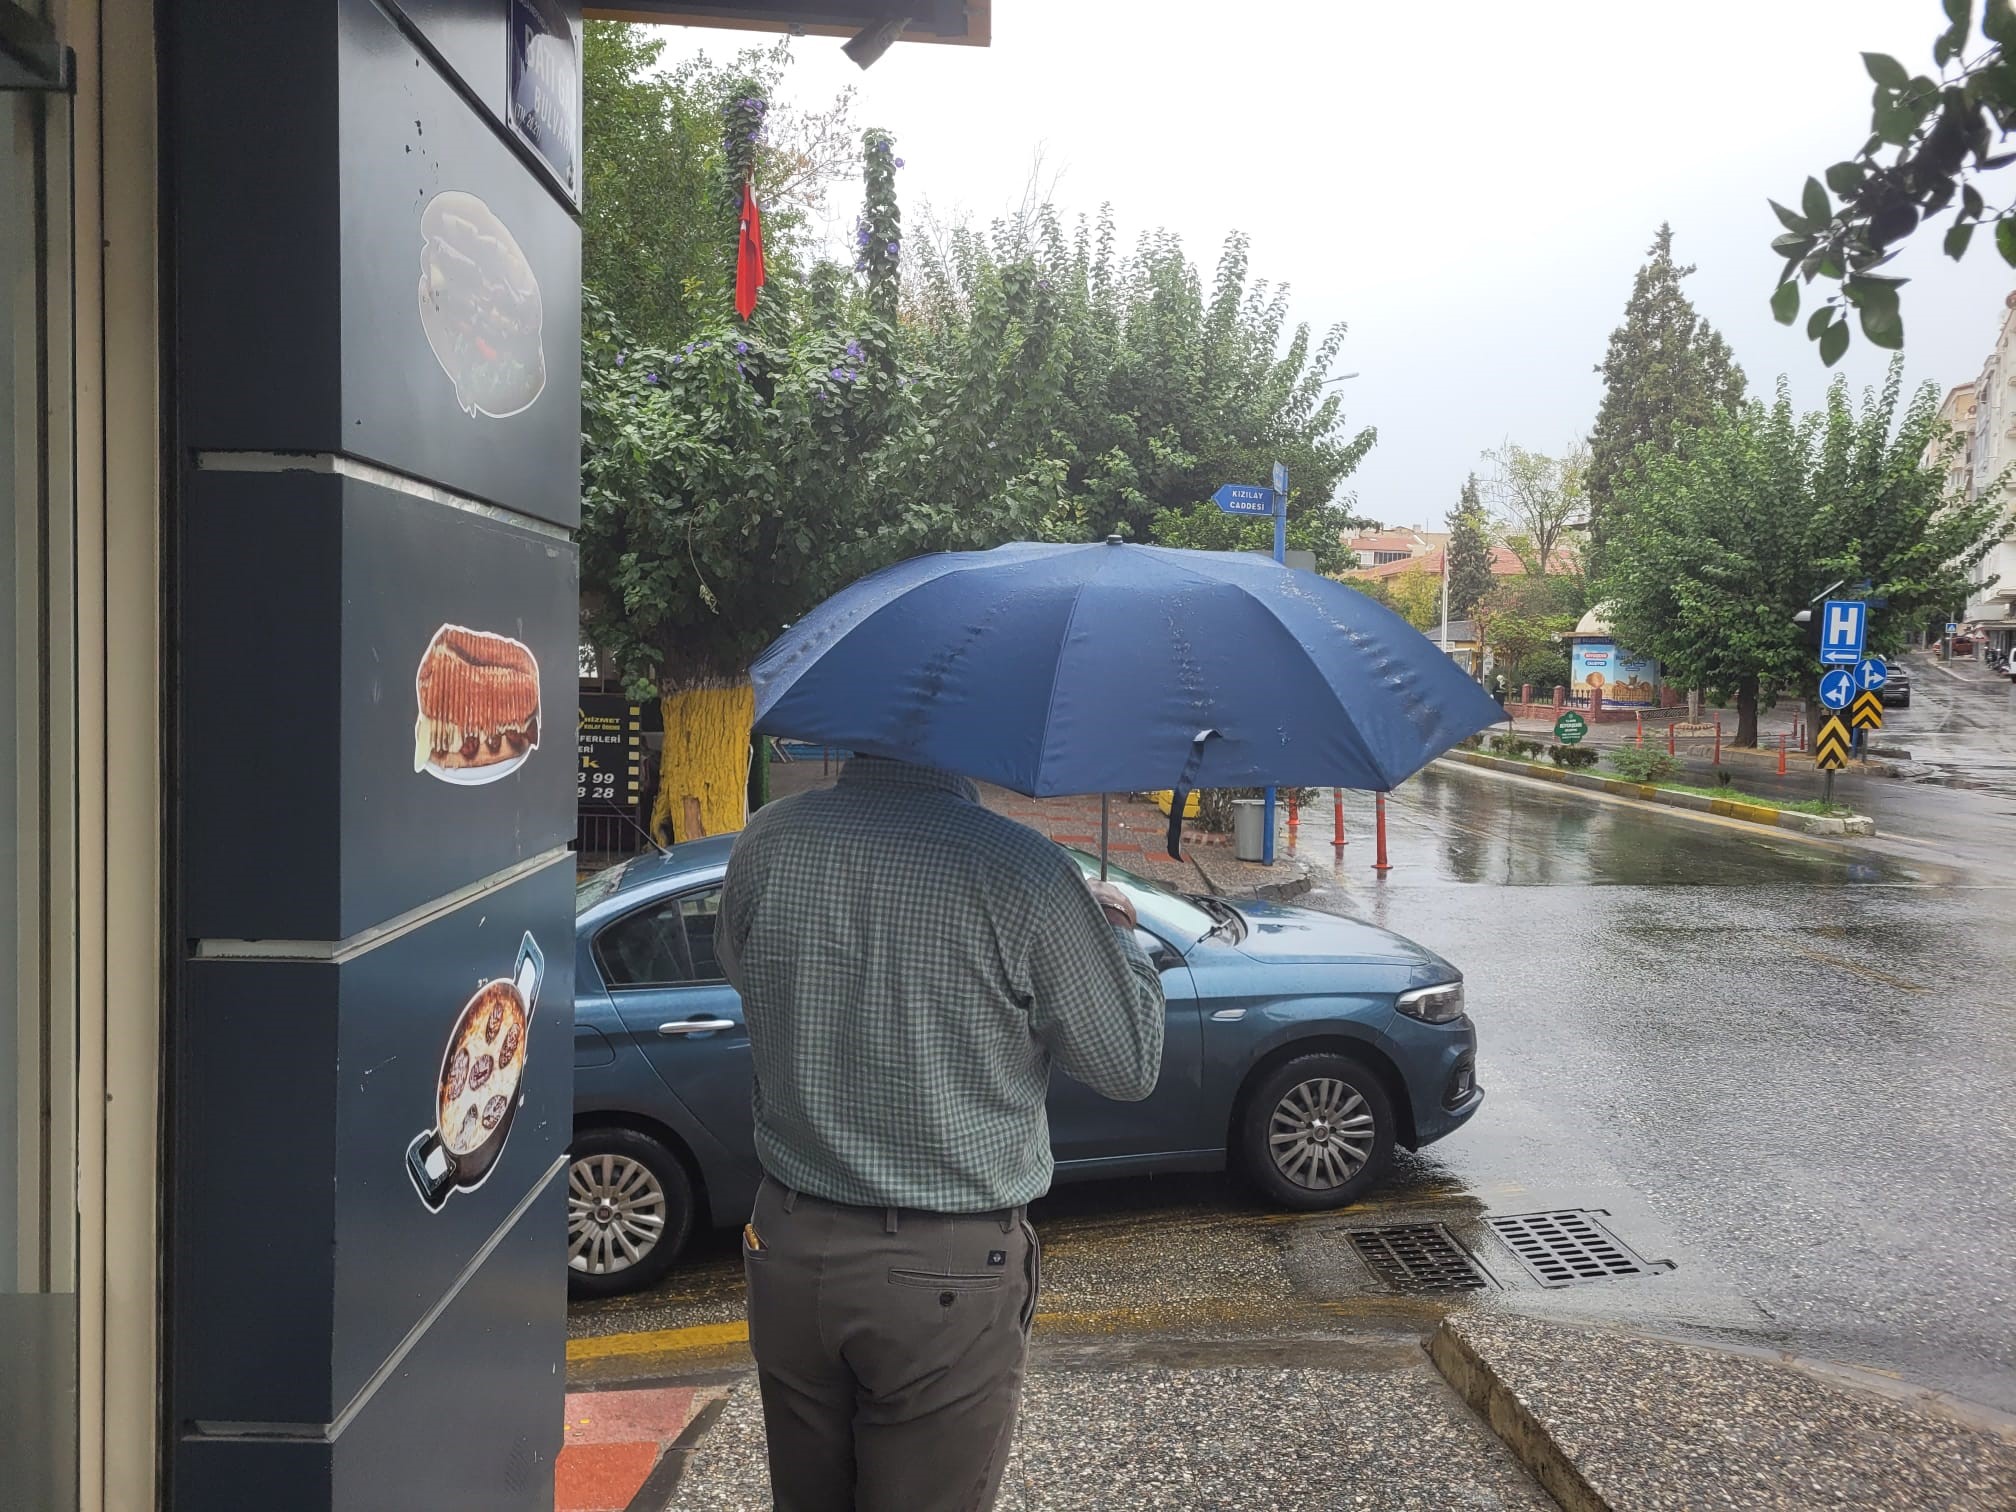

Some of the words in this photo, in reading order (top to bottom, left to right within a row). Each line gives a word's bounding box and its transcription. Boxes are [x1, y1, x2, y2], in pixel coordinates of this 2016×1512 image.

[1232, 490, 1263, 499] KIZILAY
[1829, 607, 1858, 645] H
[579, 734, 621, 744] FERLERİ
[577, 744, 594, 753] ERİ
[577, 772, 586, 783] 3
[592, 772, 615, 784] 99
[577, 786, 586, 798] 8
[592, 787, 615, 799] 28
